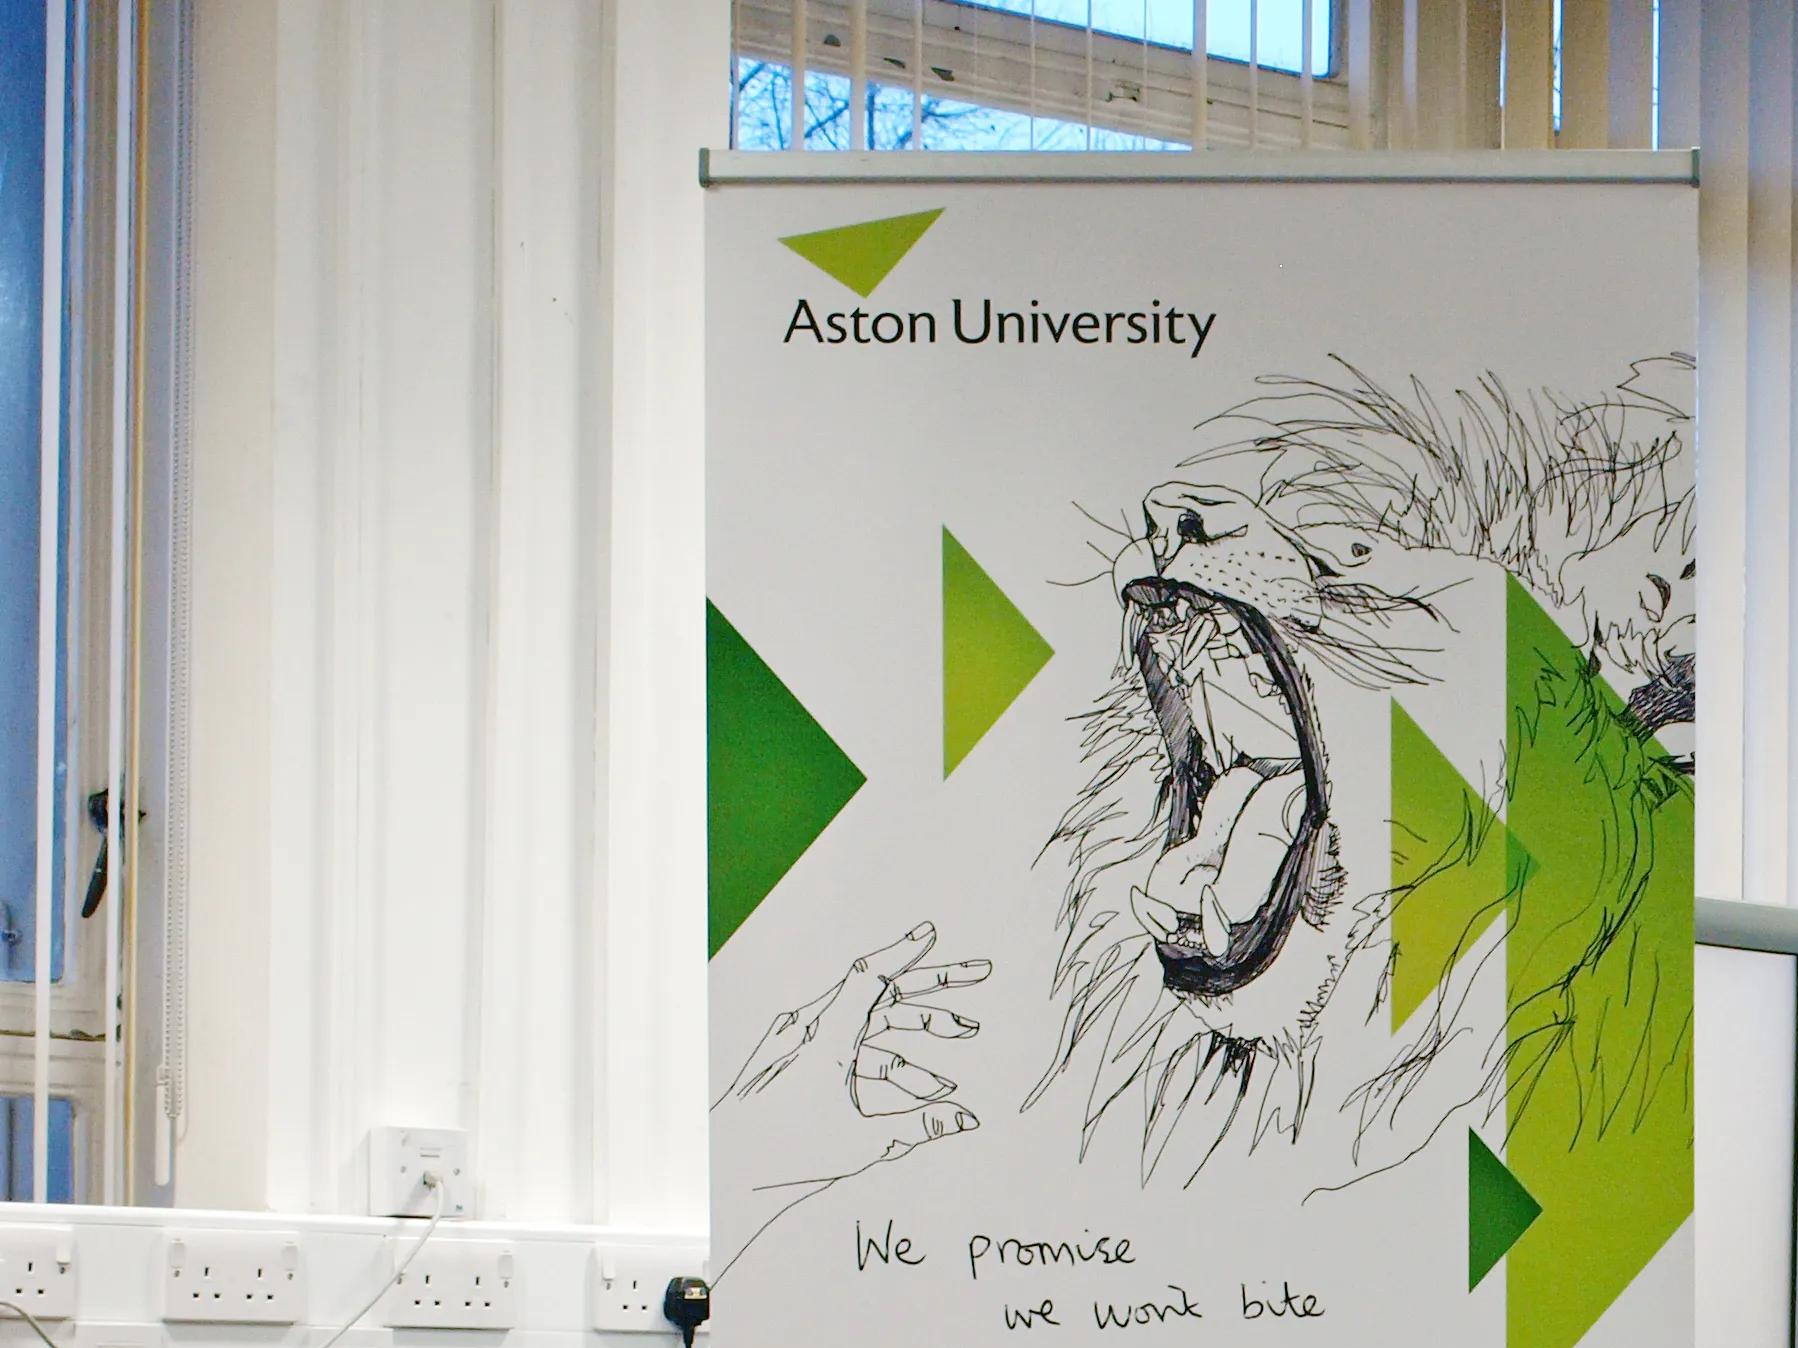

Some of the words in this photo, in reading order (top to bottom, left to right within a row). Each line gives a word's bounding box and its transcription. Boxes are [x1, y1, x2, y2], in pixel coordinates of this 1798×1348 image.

[783, 299, 936, 344] Aston
[952, 299, 1216, 359] University
[856, 1219, 926, 1271] We
[969, 1229, 1136, 1280] promise
[1005, 1299, 1061, 1330] we
[1241, 1281, 1326, 1319] bite
